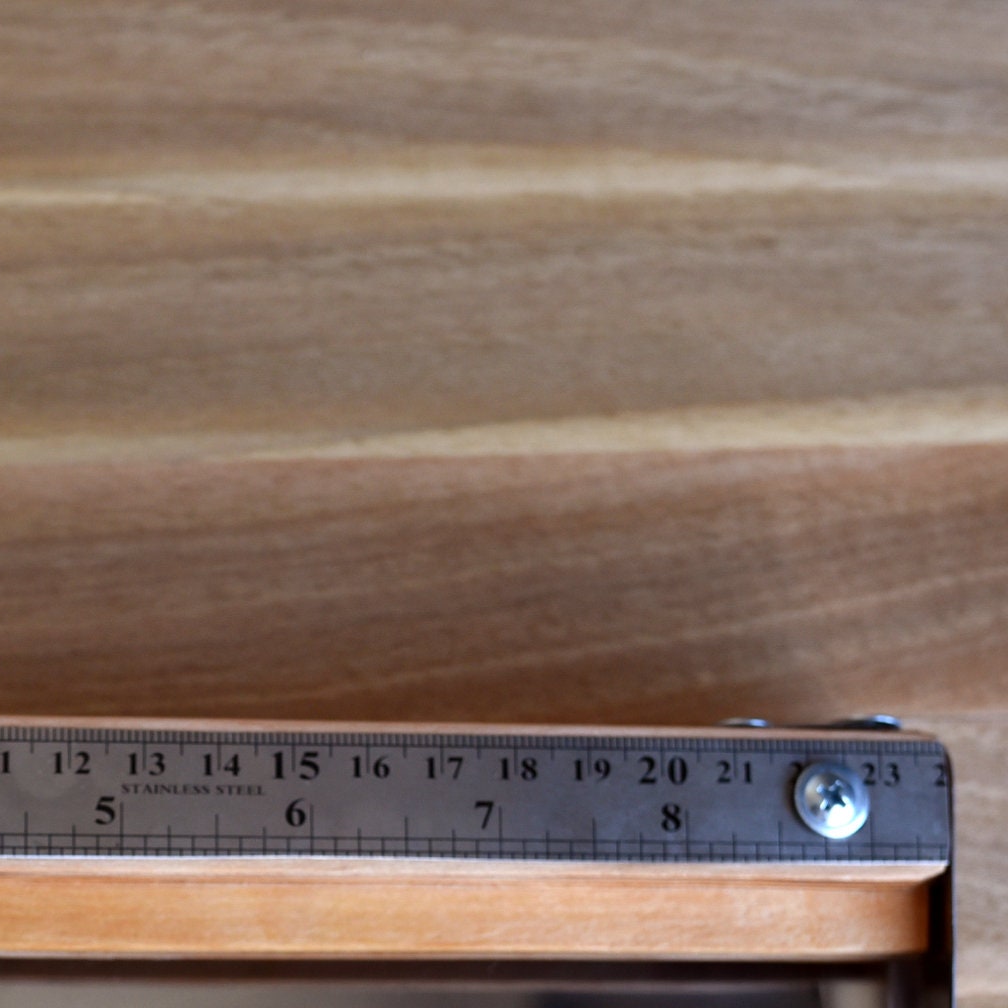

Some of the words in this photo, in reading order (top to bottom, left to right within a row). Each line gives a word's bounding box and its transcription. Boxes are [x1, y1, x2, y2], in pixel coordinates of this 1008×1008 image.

[52, 750, 91, 775] 12
[127, 752, 167, 776] 13
[202, 753, 241, 777] 14
[272, 751, 321, 781] 15
[352, 755, 391, 780] 16
[426, 756, 464, 780] 17
[499, 757, 538, 781] 18
[573, 758, 611, 782] 19
[637, 756, 688, 785] 20
[716, 759, 753, 785] 21
[120, 783, 211, 796] STAINLESS
[215, 784, 266, 796] STEEL
[94, 796, 116, 826] 5
[285, 798, 307, 827] 6
[474, 801, 495, 830] 7
[661, 804, 683, 833] 8
